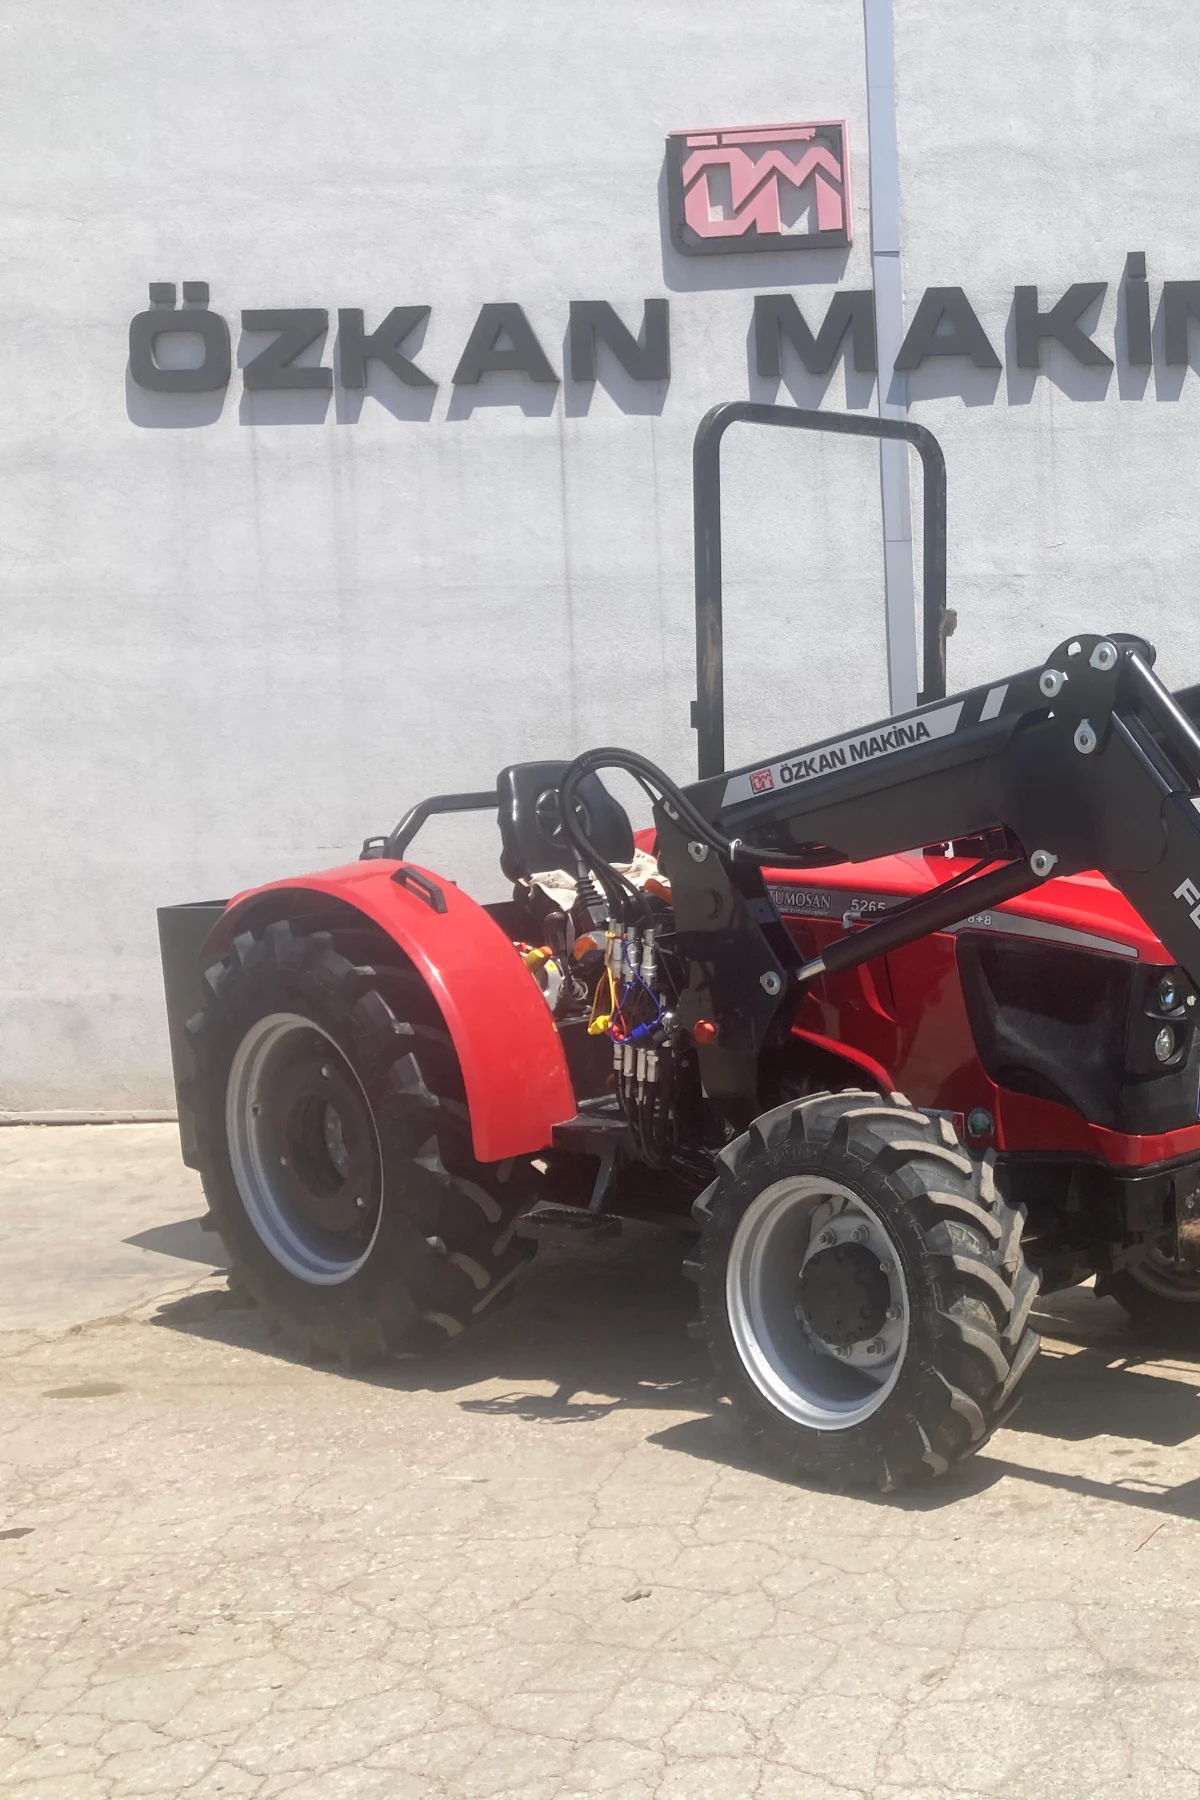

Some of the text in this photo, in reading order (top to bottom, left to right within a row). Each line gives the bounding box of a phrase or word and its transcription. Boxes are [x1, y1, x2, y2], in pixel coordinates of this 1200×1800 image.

[129, 281, 671, 393] ÖZKAN
[779, 721, 931, 783] ÖZKAN MAKİNA
[768, 887, 832, 909] TÜMOSAN
